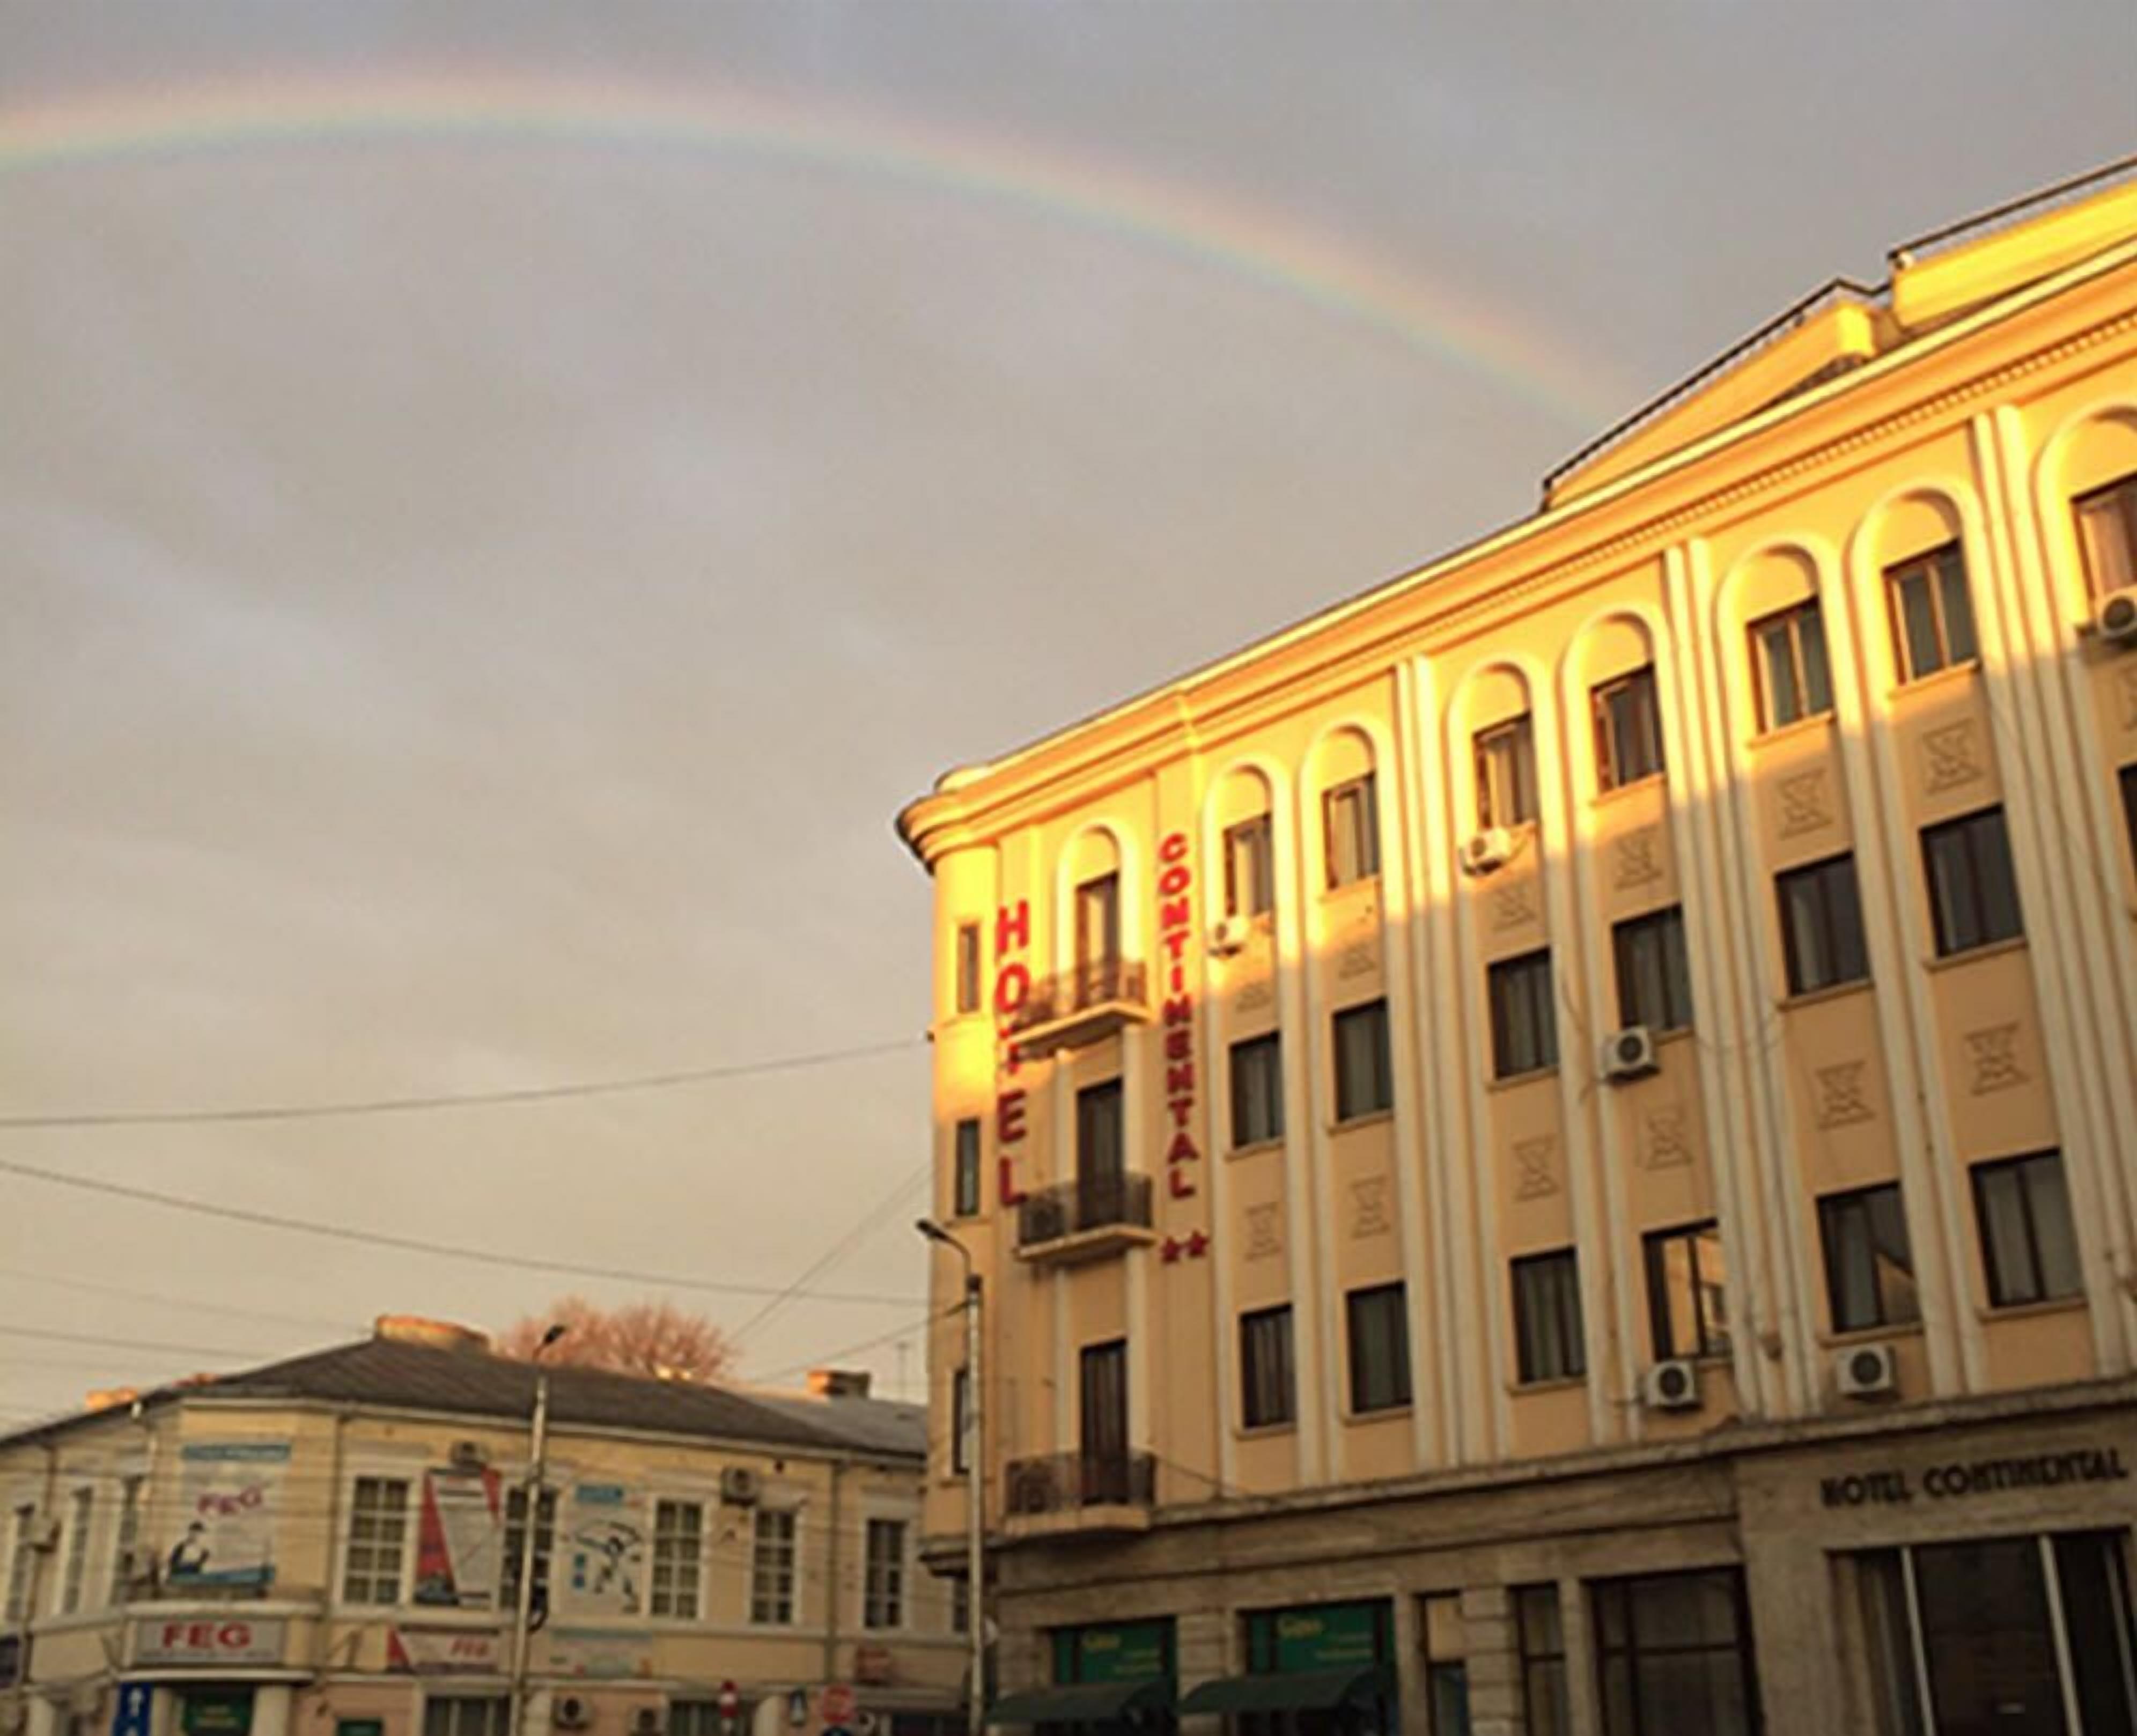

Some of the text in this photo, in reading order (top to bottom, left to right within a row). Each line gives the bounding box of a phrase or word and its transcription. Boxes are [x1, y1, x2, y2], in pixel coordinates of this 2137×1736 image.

[996, 899, 1030, 1208] HOTEL
[1159, 832, 1199, 1198] CONTINENTAL
[1821, 1447, 2128, 1506] HOTEL CONTINENTAL
[162, 1621, 251, 1650] FEG
